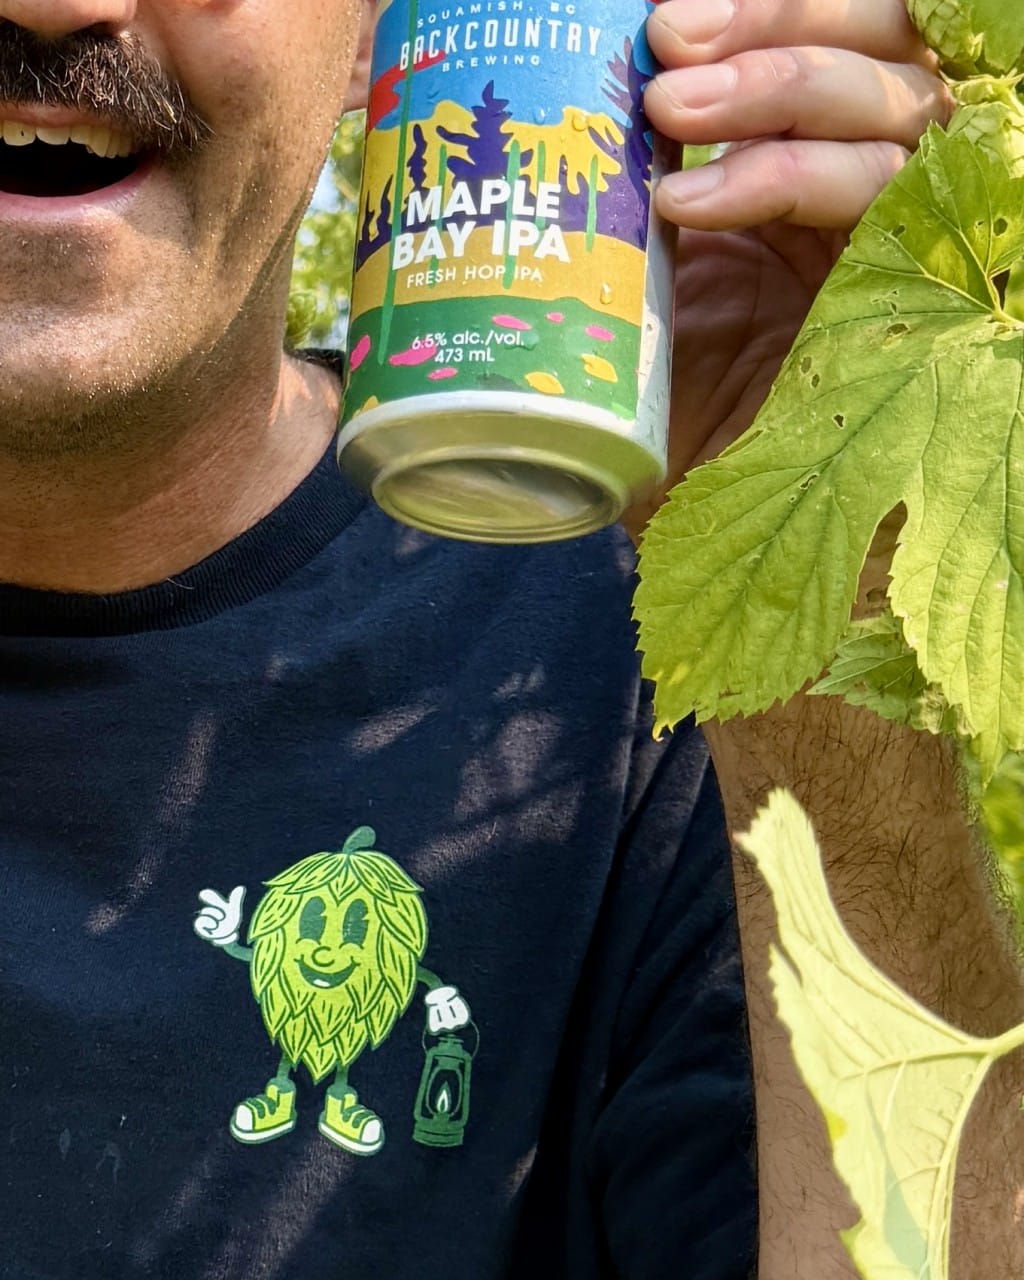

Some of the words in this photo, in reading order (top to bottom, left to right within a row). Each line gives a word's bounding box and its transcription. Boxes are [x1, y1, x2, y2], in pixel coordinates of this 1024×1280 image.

[417, 0, 534, 29] SQUAMISH,
[550, 2, 577, 16] BC
[399, 18, 602, 71] BACKCOUNTRY
[441, 54, 541, 72] BREWING
[406, 179, 563, 227] MAPLE
[391, 220, 478, 270] BAY
[491, 219, 571, 264] IPA
[406, 266, 456, 289] FRESH
[464, 264, 506, 281] HOP
[514, 265, 543, 282] IPA
[412, 332, 447, 350] 6.5%
[452, 330, 525, 347] alc./vol.
[434, 348, 463, 364] 473
[468, 347, 495, 363] mL
